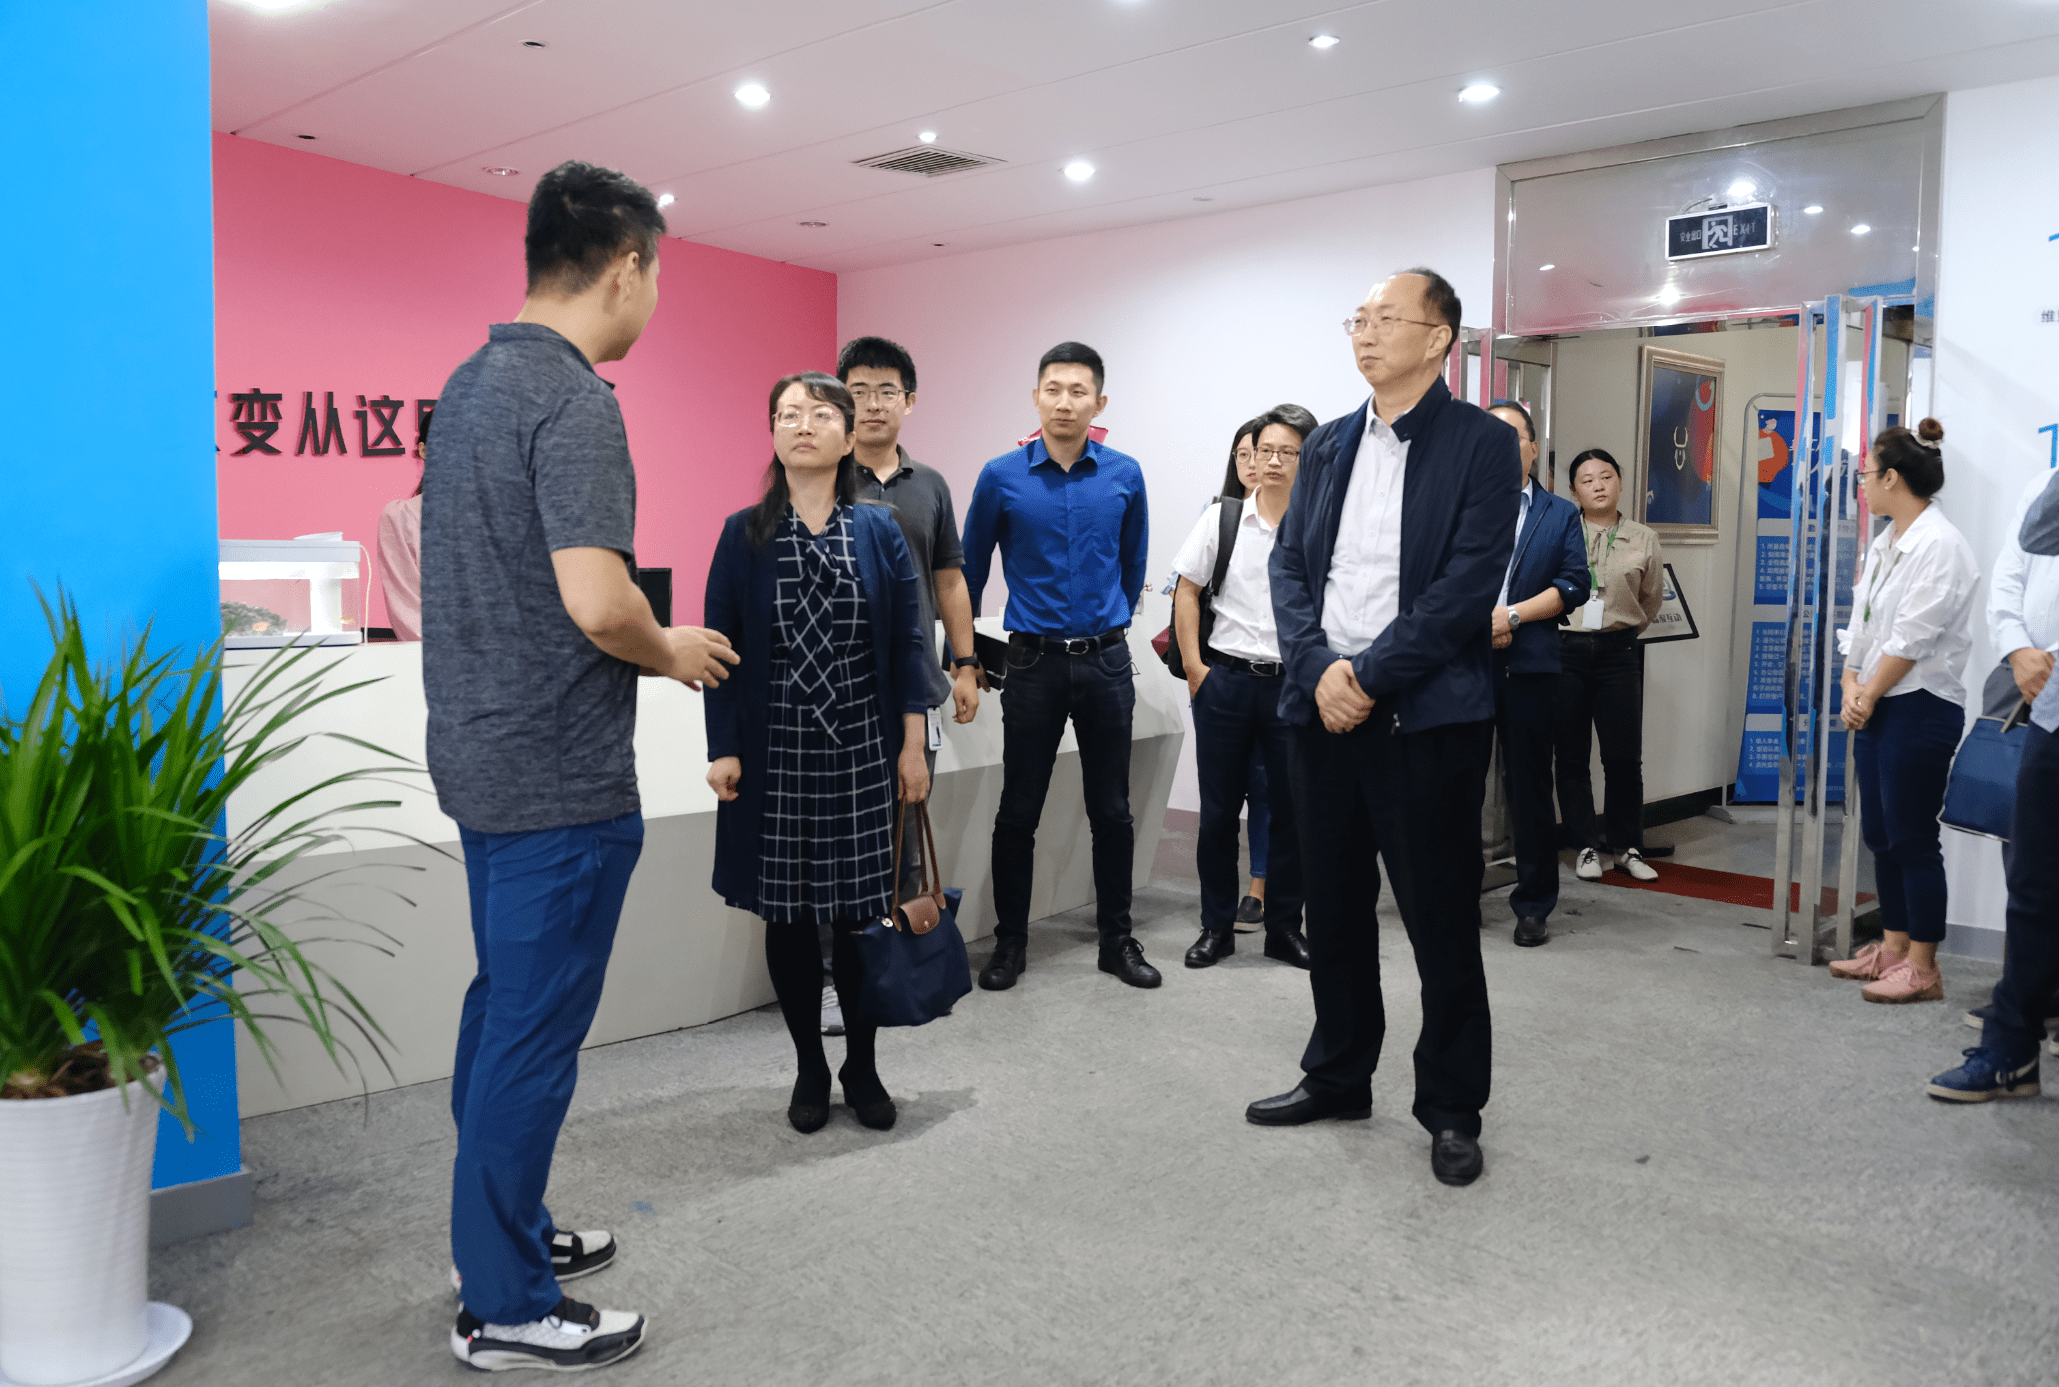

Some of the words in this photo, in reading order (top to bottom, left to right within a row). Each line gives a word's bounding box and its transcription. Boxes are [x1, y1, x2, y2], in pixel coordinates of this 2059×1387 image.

[1680, 229, 1702, 242] 安全出口
[1733, 222, 1756, 236] EXIT
[215, 388, 438, 458] 变从这
